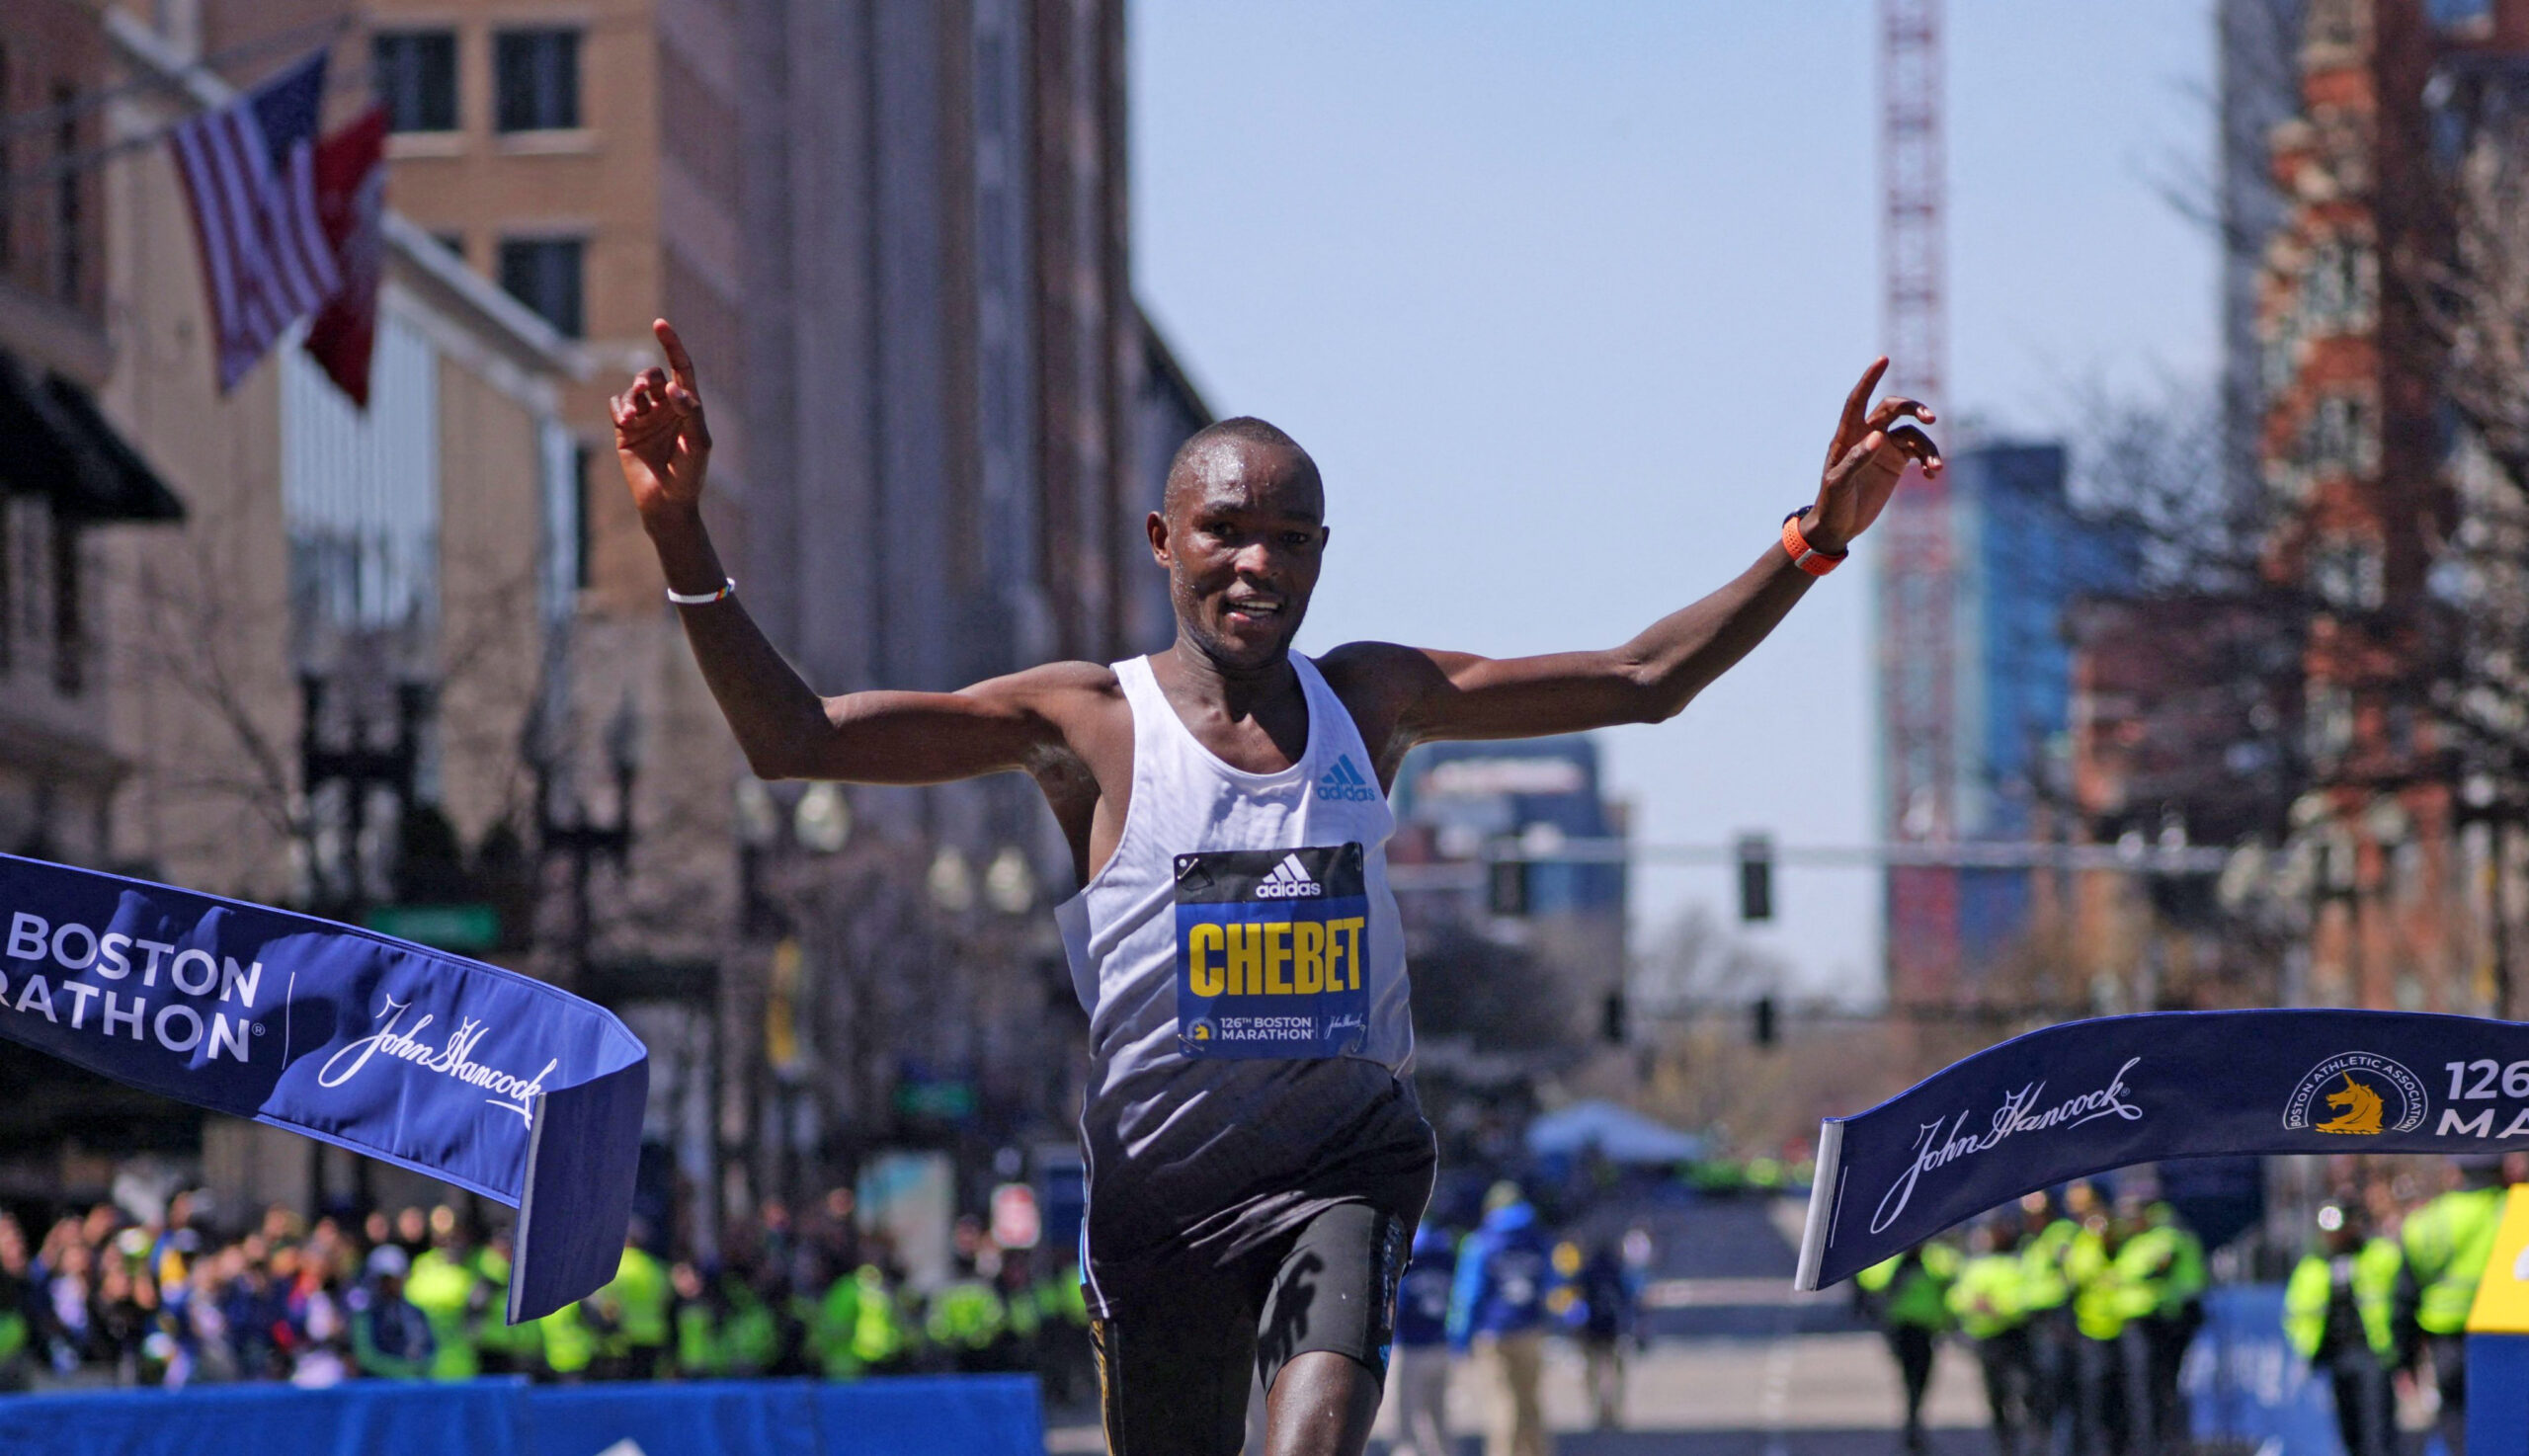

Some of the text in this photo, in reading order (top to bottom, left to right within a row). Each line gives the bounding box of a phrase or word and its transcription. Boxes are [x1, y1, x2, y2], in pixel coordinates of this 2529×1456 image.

[1317, 784, 1376, 802] adidas
[1256, 880, 1322, 898] adidas
[6, 911, 263, 1009] BOSTON
[1188, 917, 1365, 998] CHEBET
[1254, 1016, 1312, 1028] BOSTON
[318, 993, 557, 1131] John Hancock
[2290, 1056, 2422, 1130] BOSTON ATHLETIC ASSOCIATION
[1870, 1108, 1980, 1235] John
